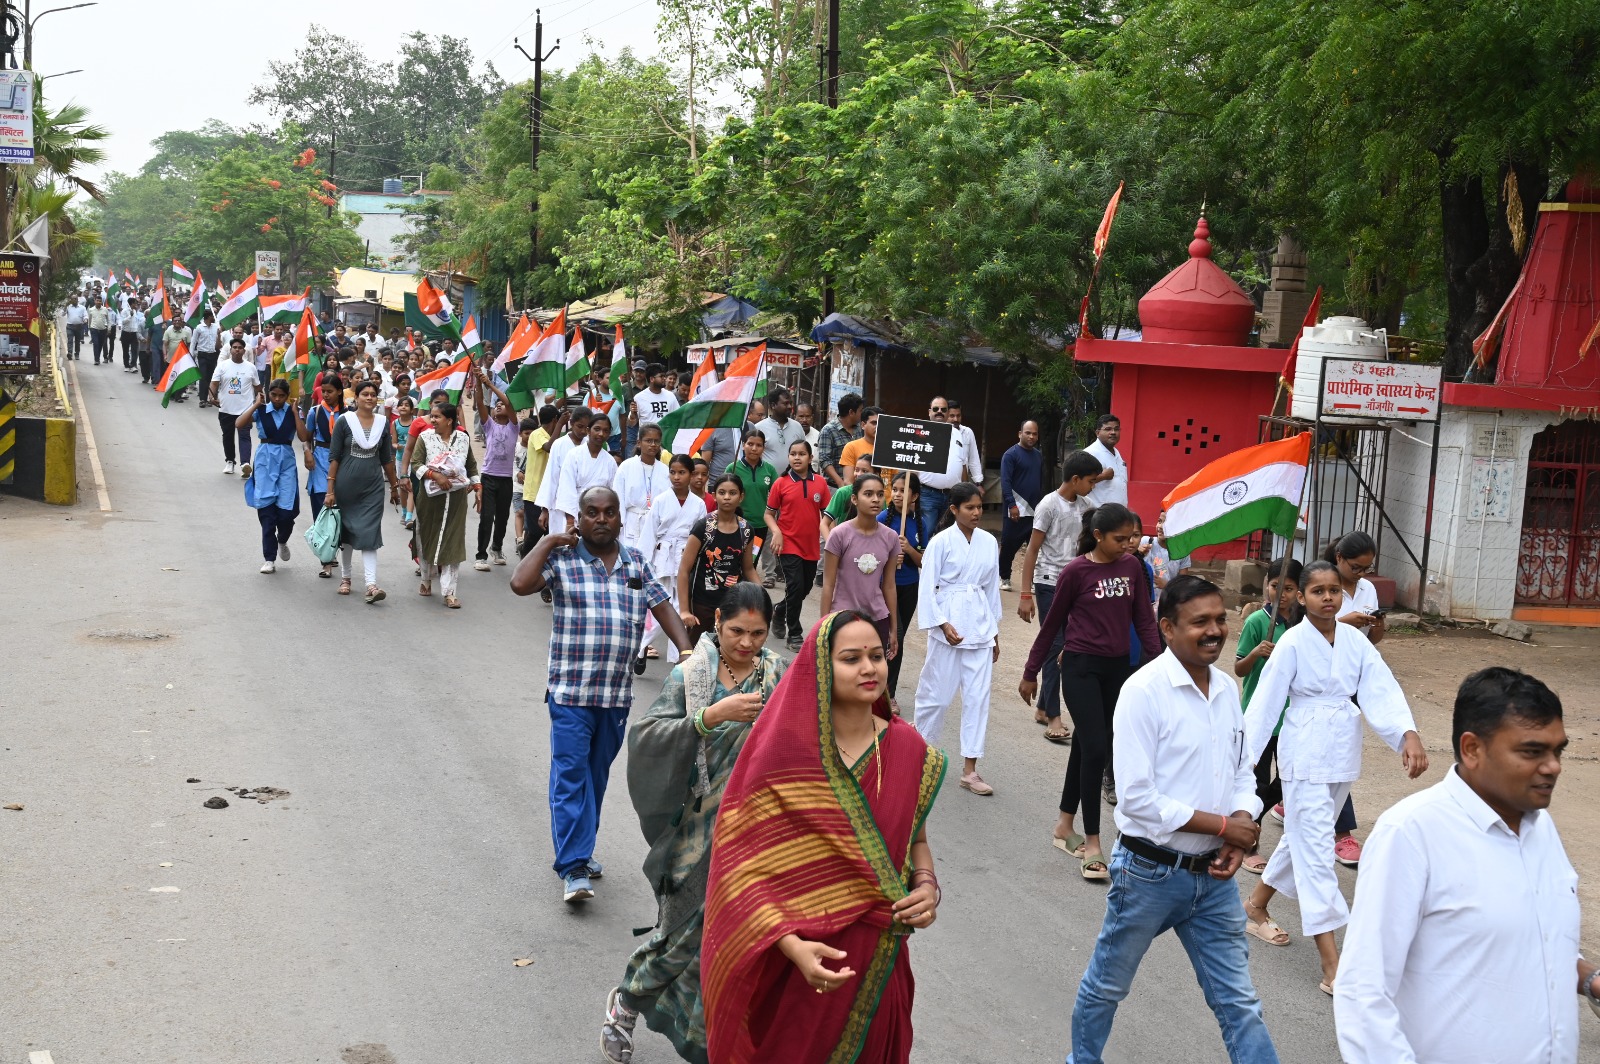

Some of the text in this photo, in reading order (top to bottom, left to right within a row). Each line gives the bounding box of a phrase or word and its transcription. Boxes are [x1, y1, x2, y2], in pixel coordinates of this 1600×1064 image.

[0, 260, 15, 268] AND
[1327, 378, 1437, 401] प्राथमिक स्वास्थ्य केन्द्र
[650, 401, 668, 413] BE
[891, 440, 934, 453] हम सेना के
[895, 453, 913, 463] साथ
[1094, 577, 1131, 599] JUST
